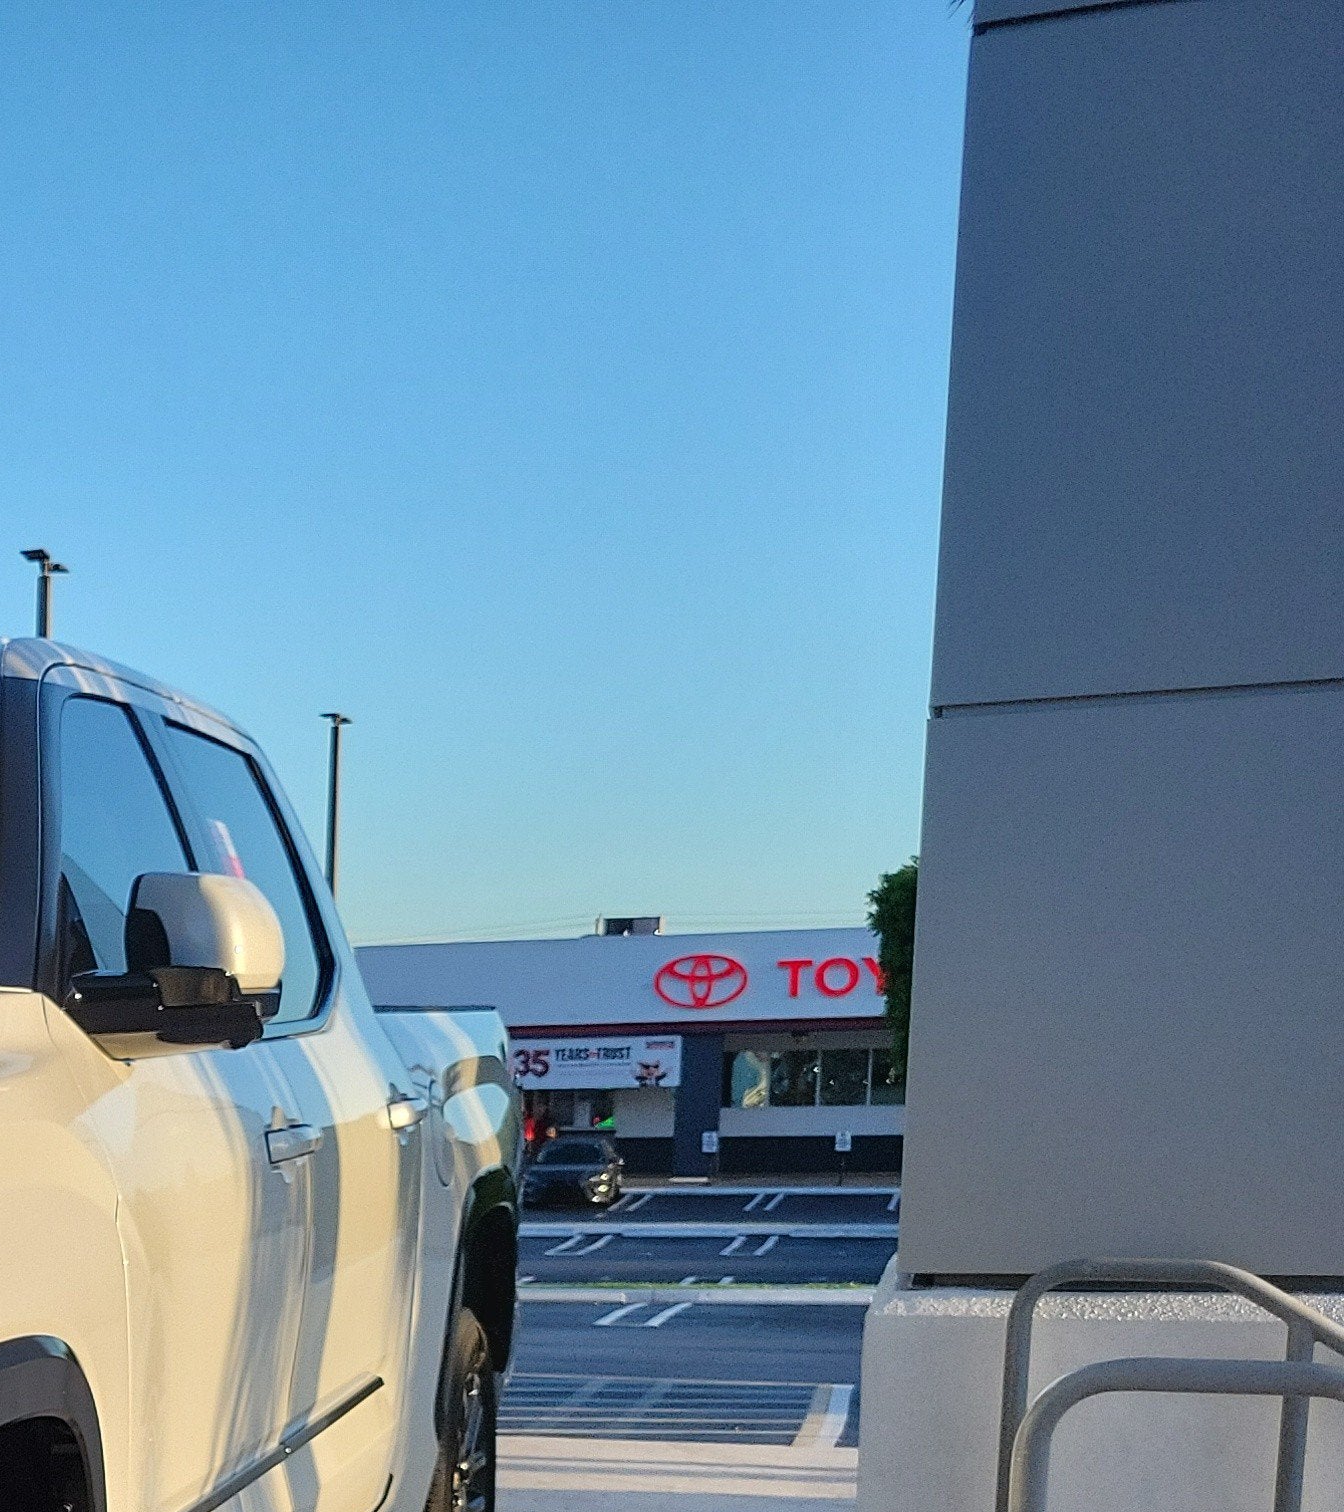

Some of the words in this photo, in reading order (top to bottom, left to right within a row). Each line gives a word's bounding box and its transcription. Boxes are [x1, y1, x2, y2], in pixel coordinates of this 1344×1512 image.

[514, 1048, 550, 1077] 35
[555, 1048, 589, 1061] YEARS
[597, 1046, 631, 1060] TRUST
